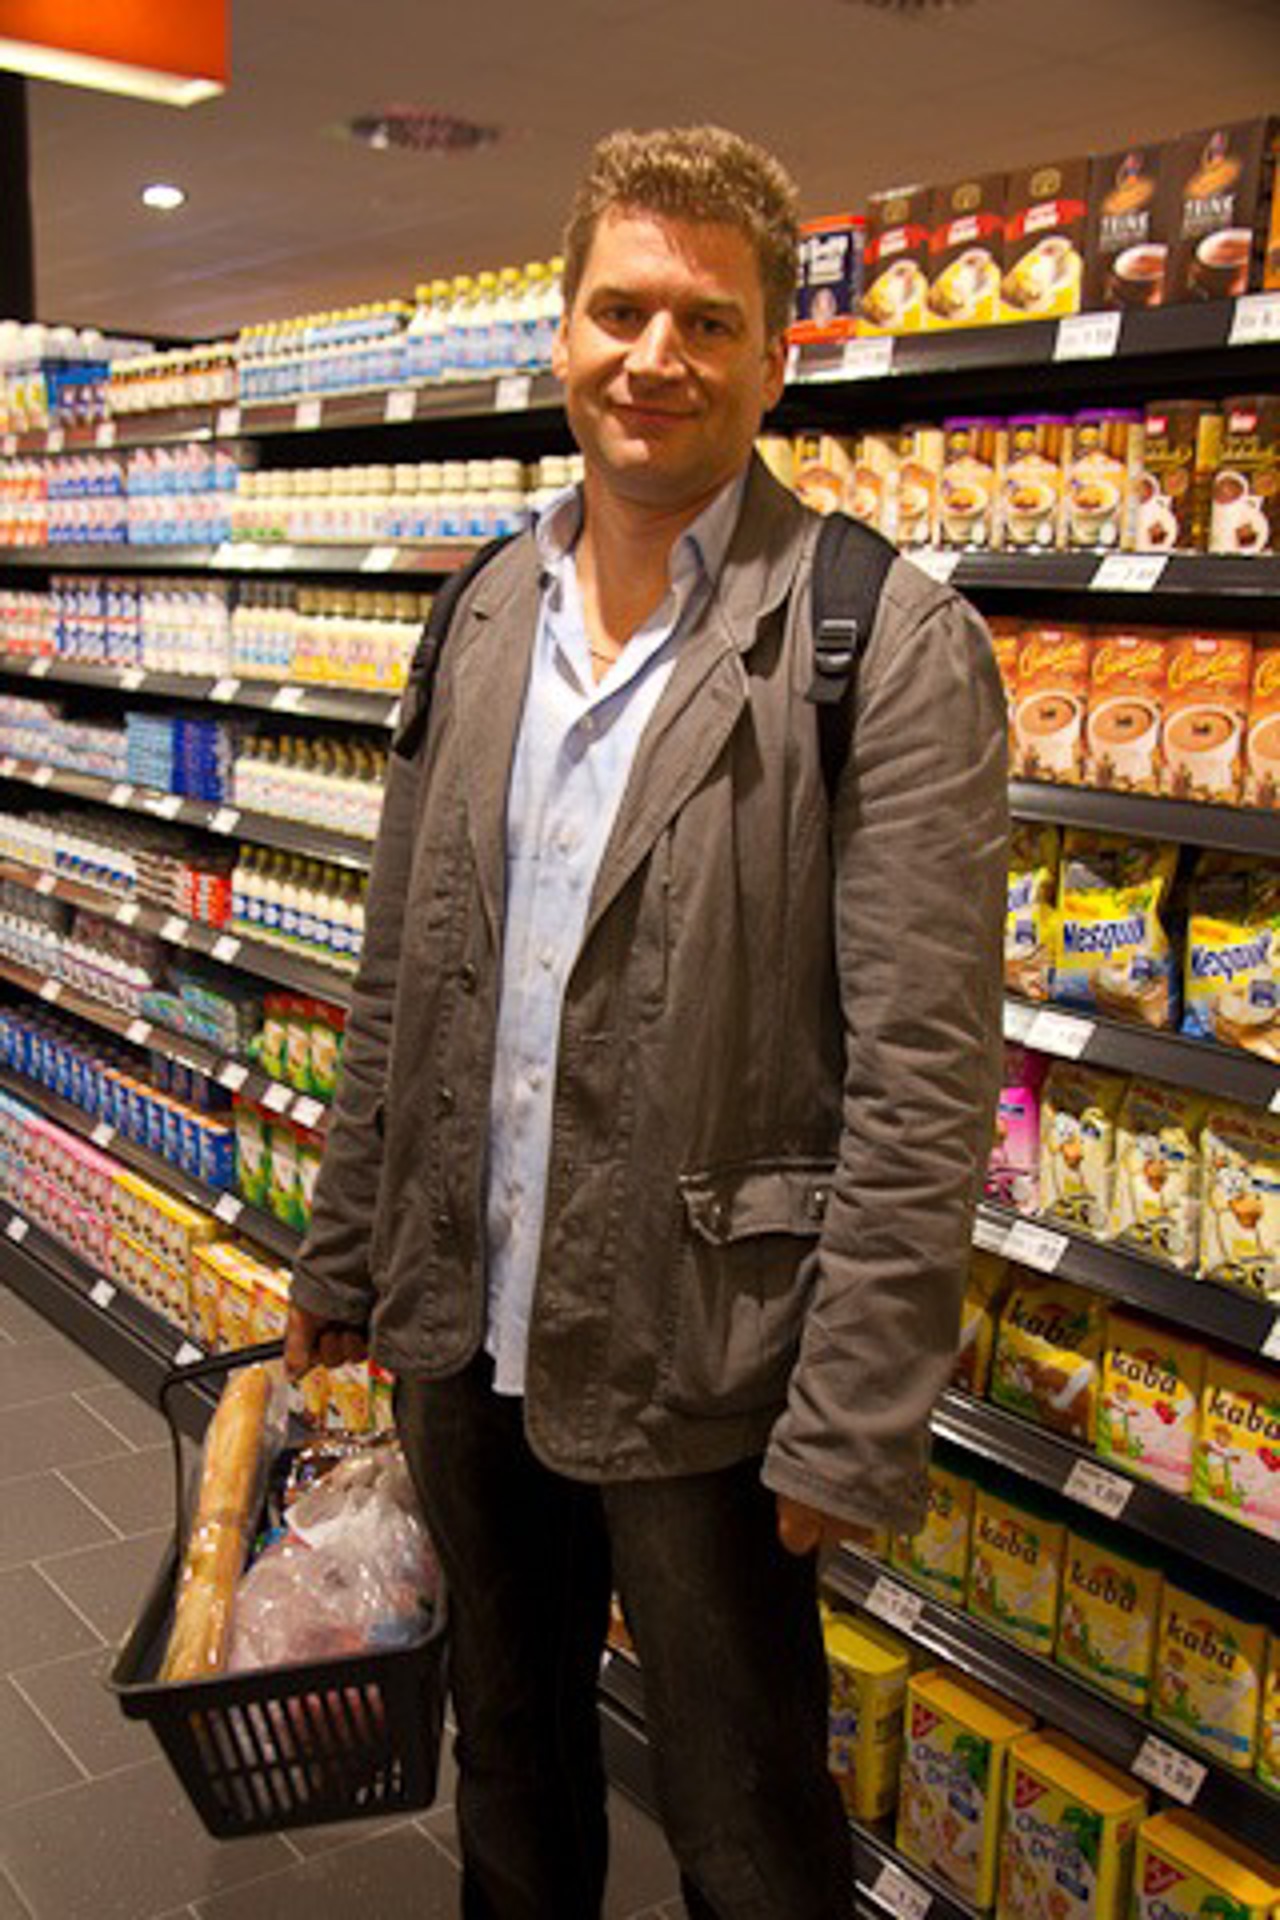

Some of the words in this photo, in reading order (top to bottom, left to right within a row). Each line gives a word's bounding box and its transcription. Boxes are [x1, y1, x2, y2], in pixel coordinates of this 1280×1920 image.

[1110, 1347, 1178, 1397] kaba
[1207, 1388, 1280, 1440] kaba
[979, 1514, 1038, 1565] kaba
[1071, 1559, 1136, 1613] kaba
[1167, 1611, 1236, 1670] kaba
